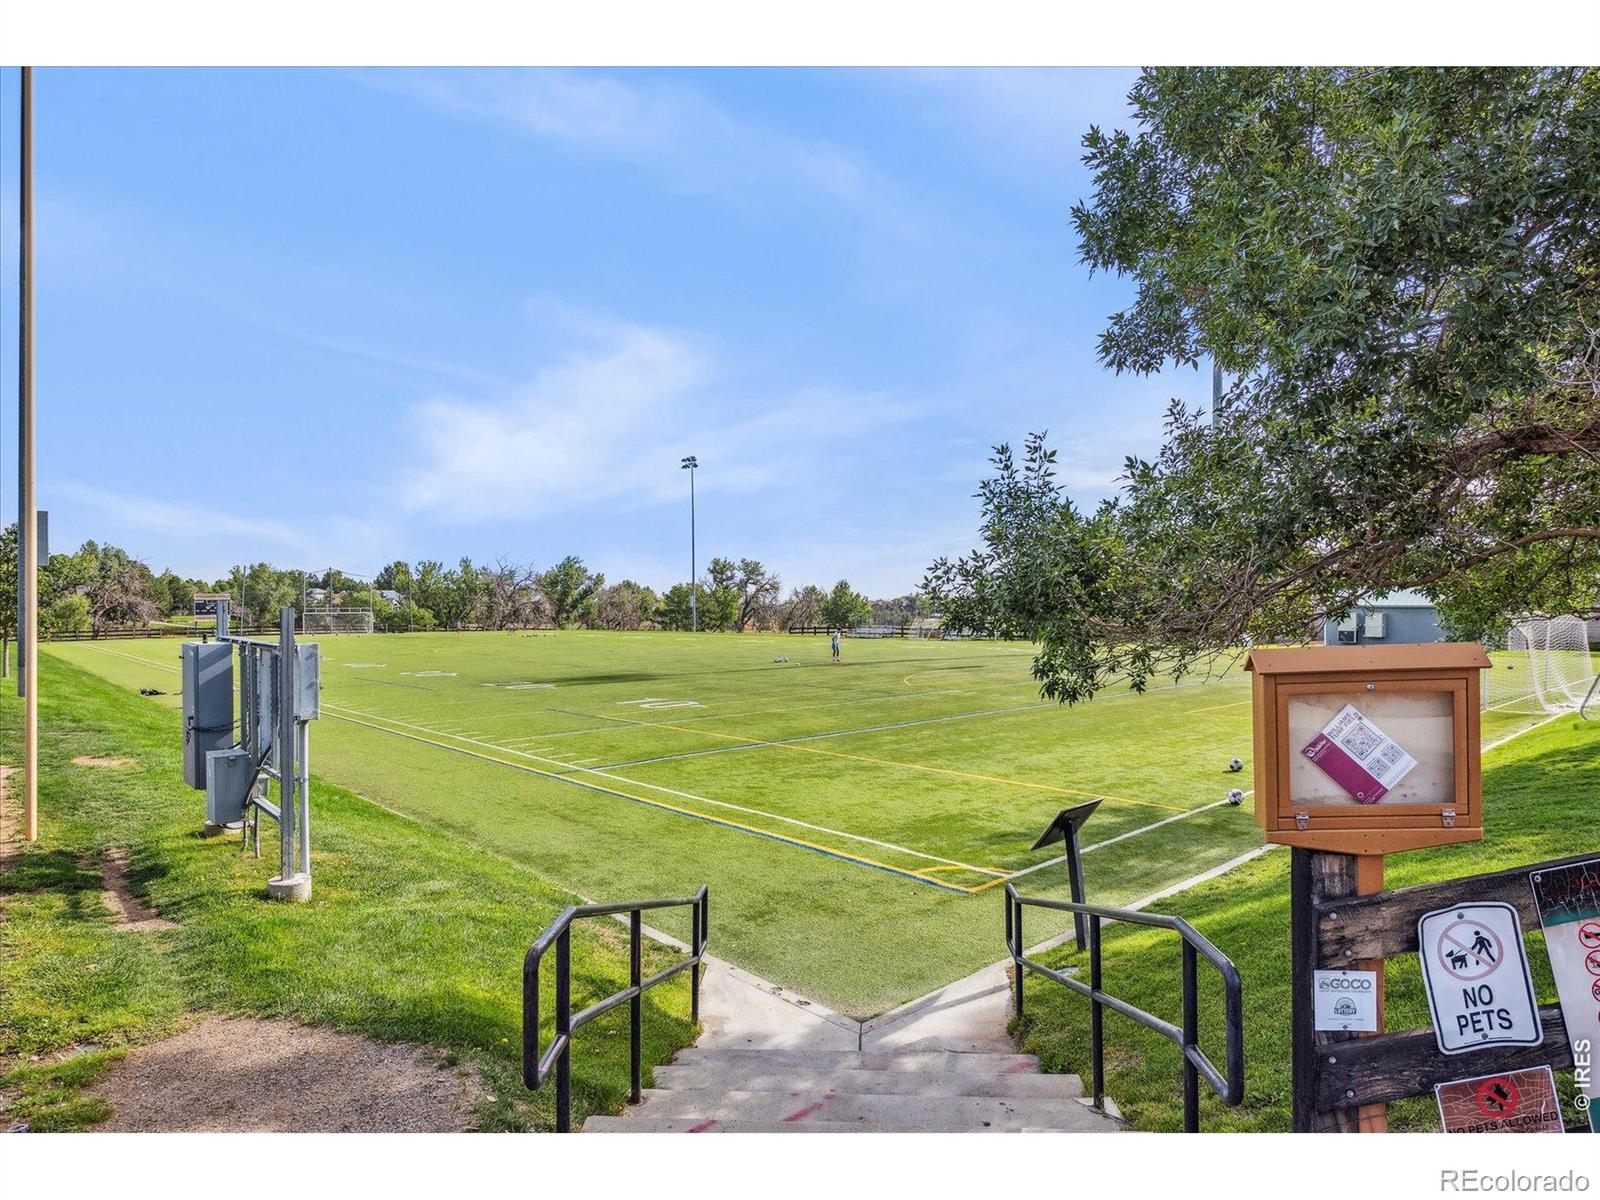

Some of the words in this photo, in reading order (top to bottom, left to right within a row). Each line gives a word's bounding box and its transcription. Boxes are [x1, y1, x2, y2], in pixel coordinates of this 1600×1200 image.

[1327, 712, 1351, 737] WILLIAMS
[1330, 978, 1372, 990] GOCO
[1462, 984, 1494, 1009] NO
[1456, 1008, 1513, 1036] PETS
[1468, 1121, 1498, 1133] PETS
[1500, 1111, 1558, 1129] ALLOWED
